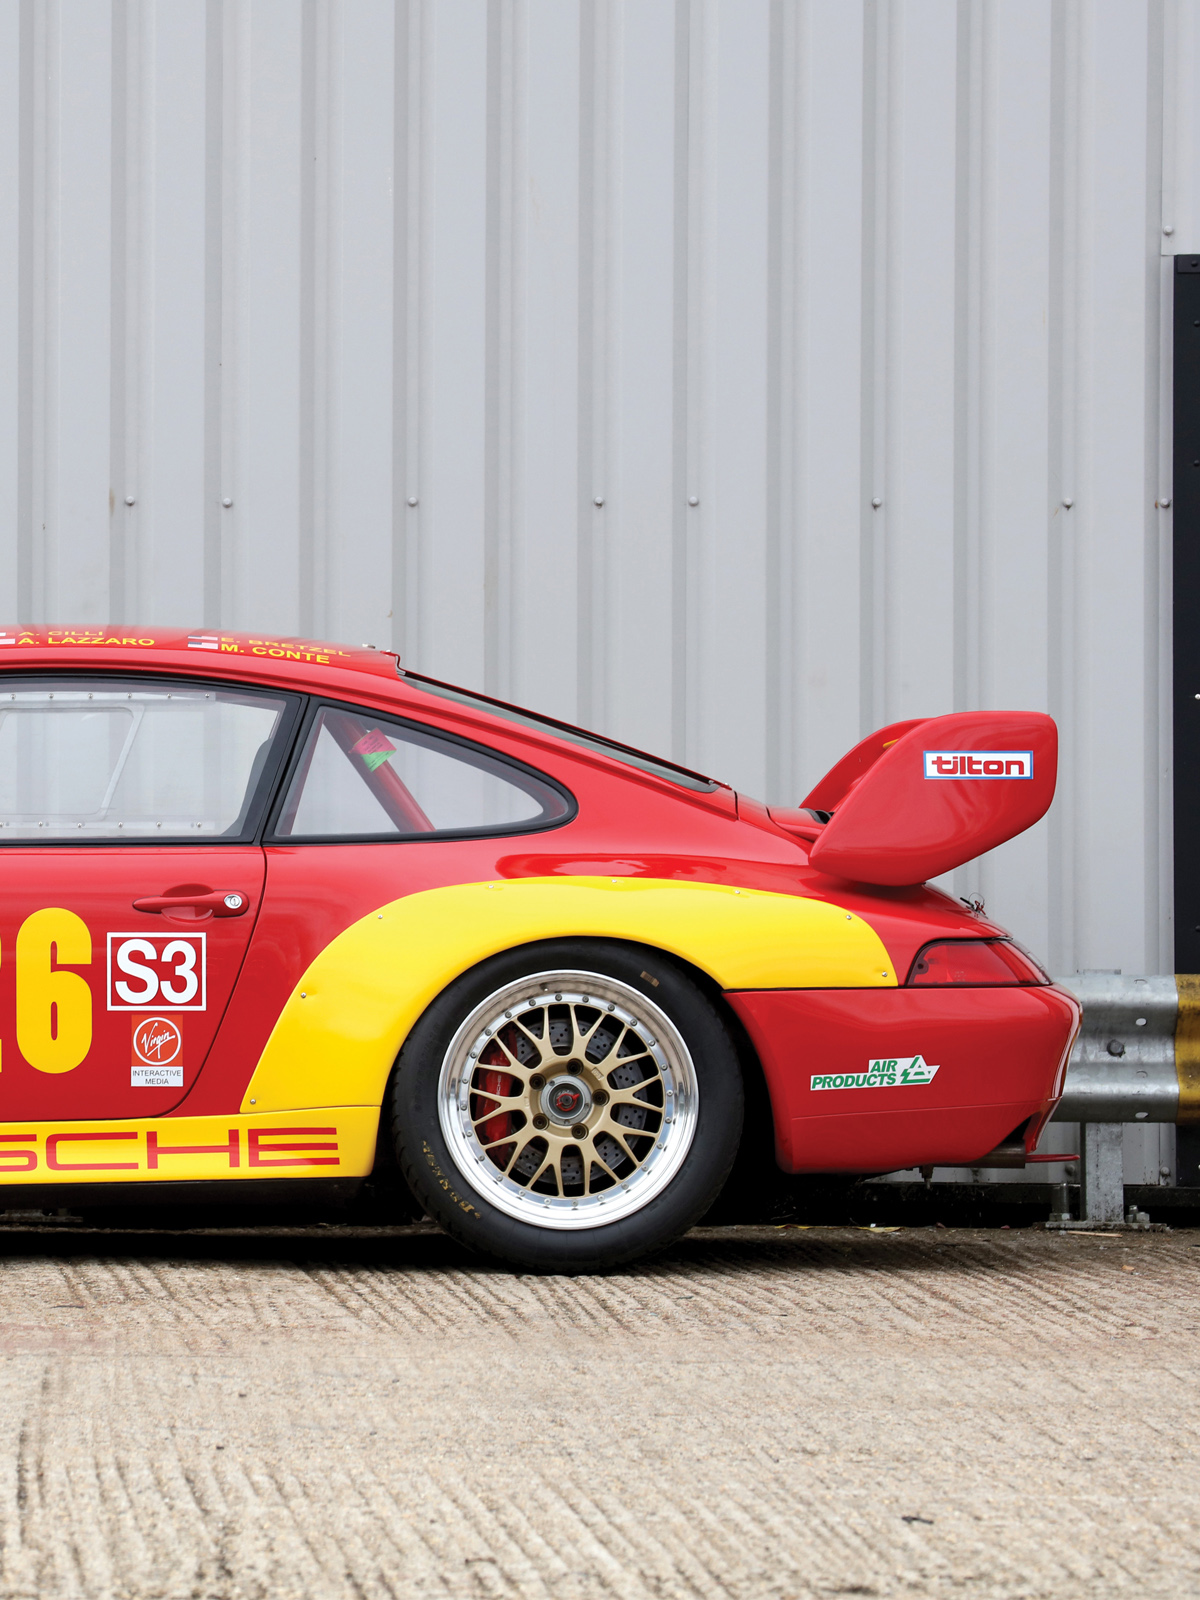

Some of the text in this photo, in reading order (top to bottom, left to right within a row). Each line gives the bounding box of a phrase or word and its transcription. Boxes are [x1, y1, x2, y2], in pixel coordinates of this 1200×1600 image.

[17, 637, 155, 645] A. LAZZARO
[221, 644, 330, 664] M. CONTE
[931, 756, 1025, 775] tilton
[115, 938, 199, 1004] S3
[140, 1022, 176, 1059] Virgin
[870, 1060, 898, 1073] AIR
[811, 1073, 896, 1089] PRODUCTS
